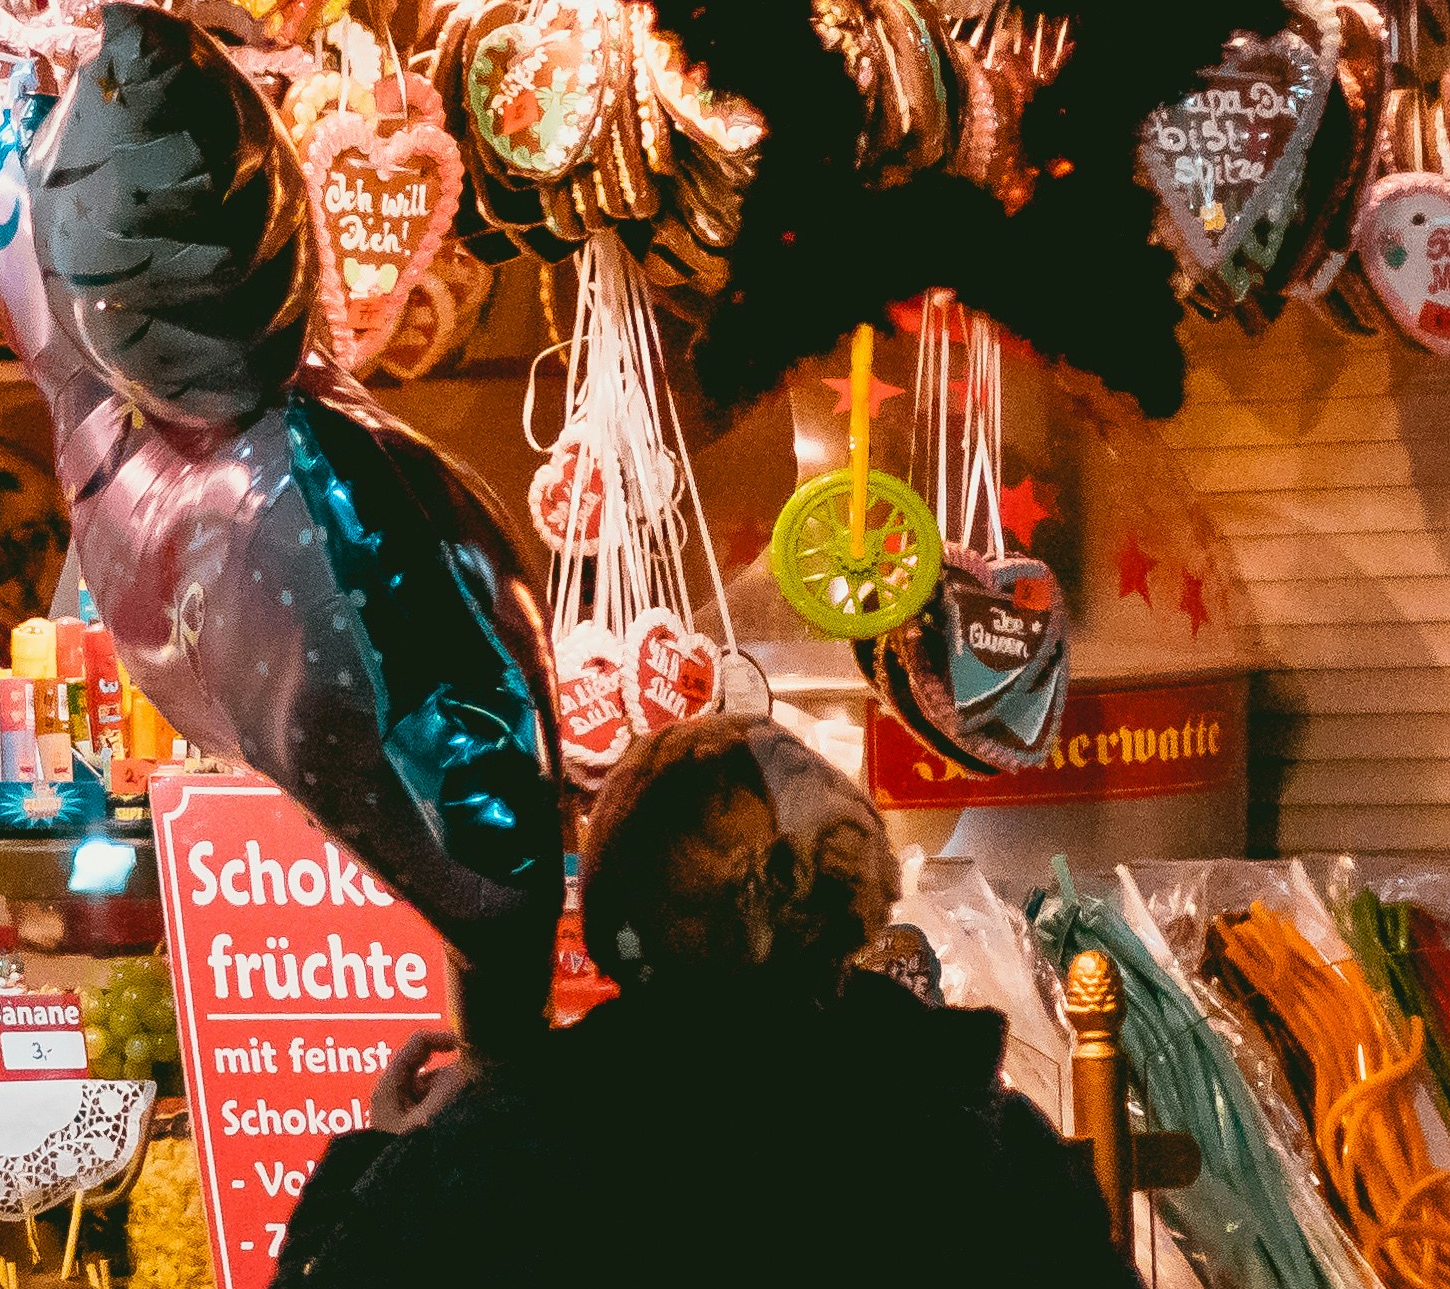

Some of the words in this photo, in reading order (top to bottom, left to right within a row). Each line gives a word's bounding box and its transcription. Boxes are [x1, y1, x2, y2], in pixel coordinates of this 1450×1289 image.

[382, 184, 432, 217] will
[912, 714, 1221, 783] erwatte
[207, 931, 428, 1001] früchte
[214, 1036, 278, 1074] mit
[288, 1037, 392, 1074] feinst
